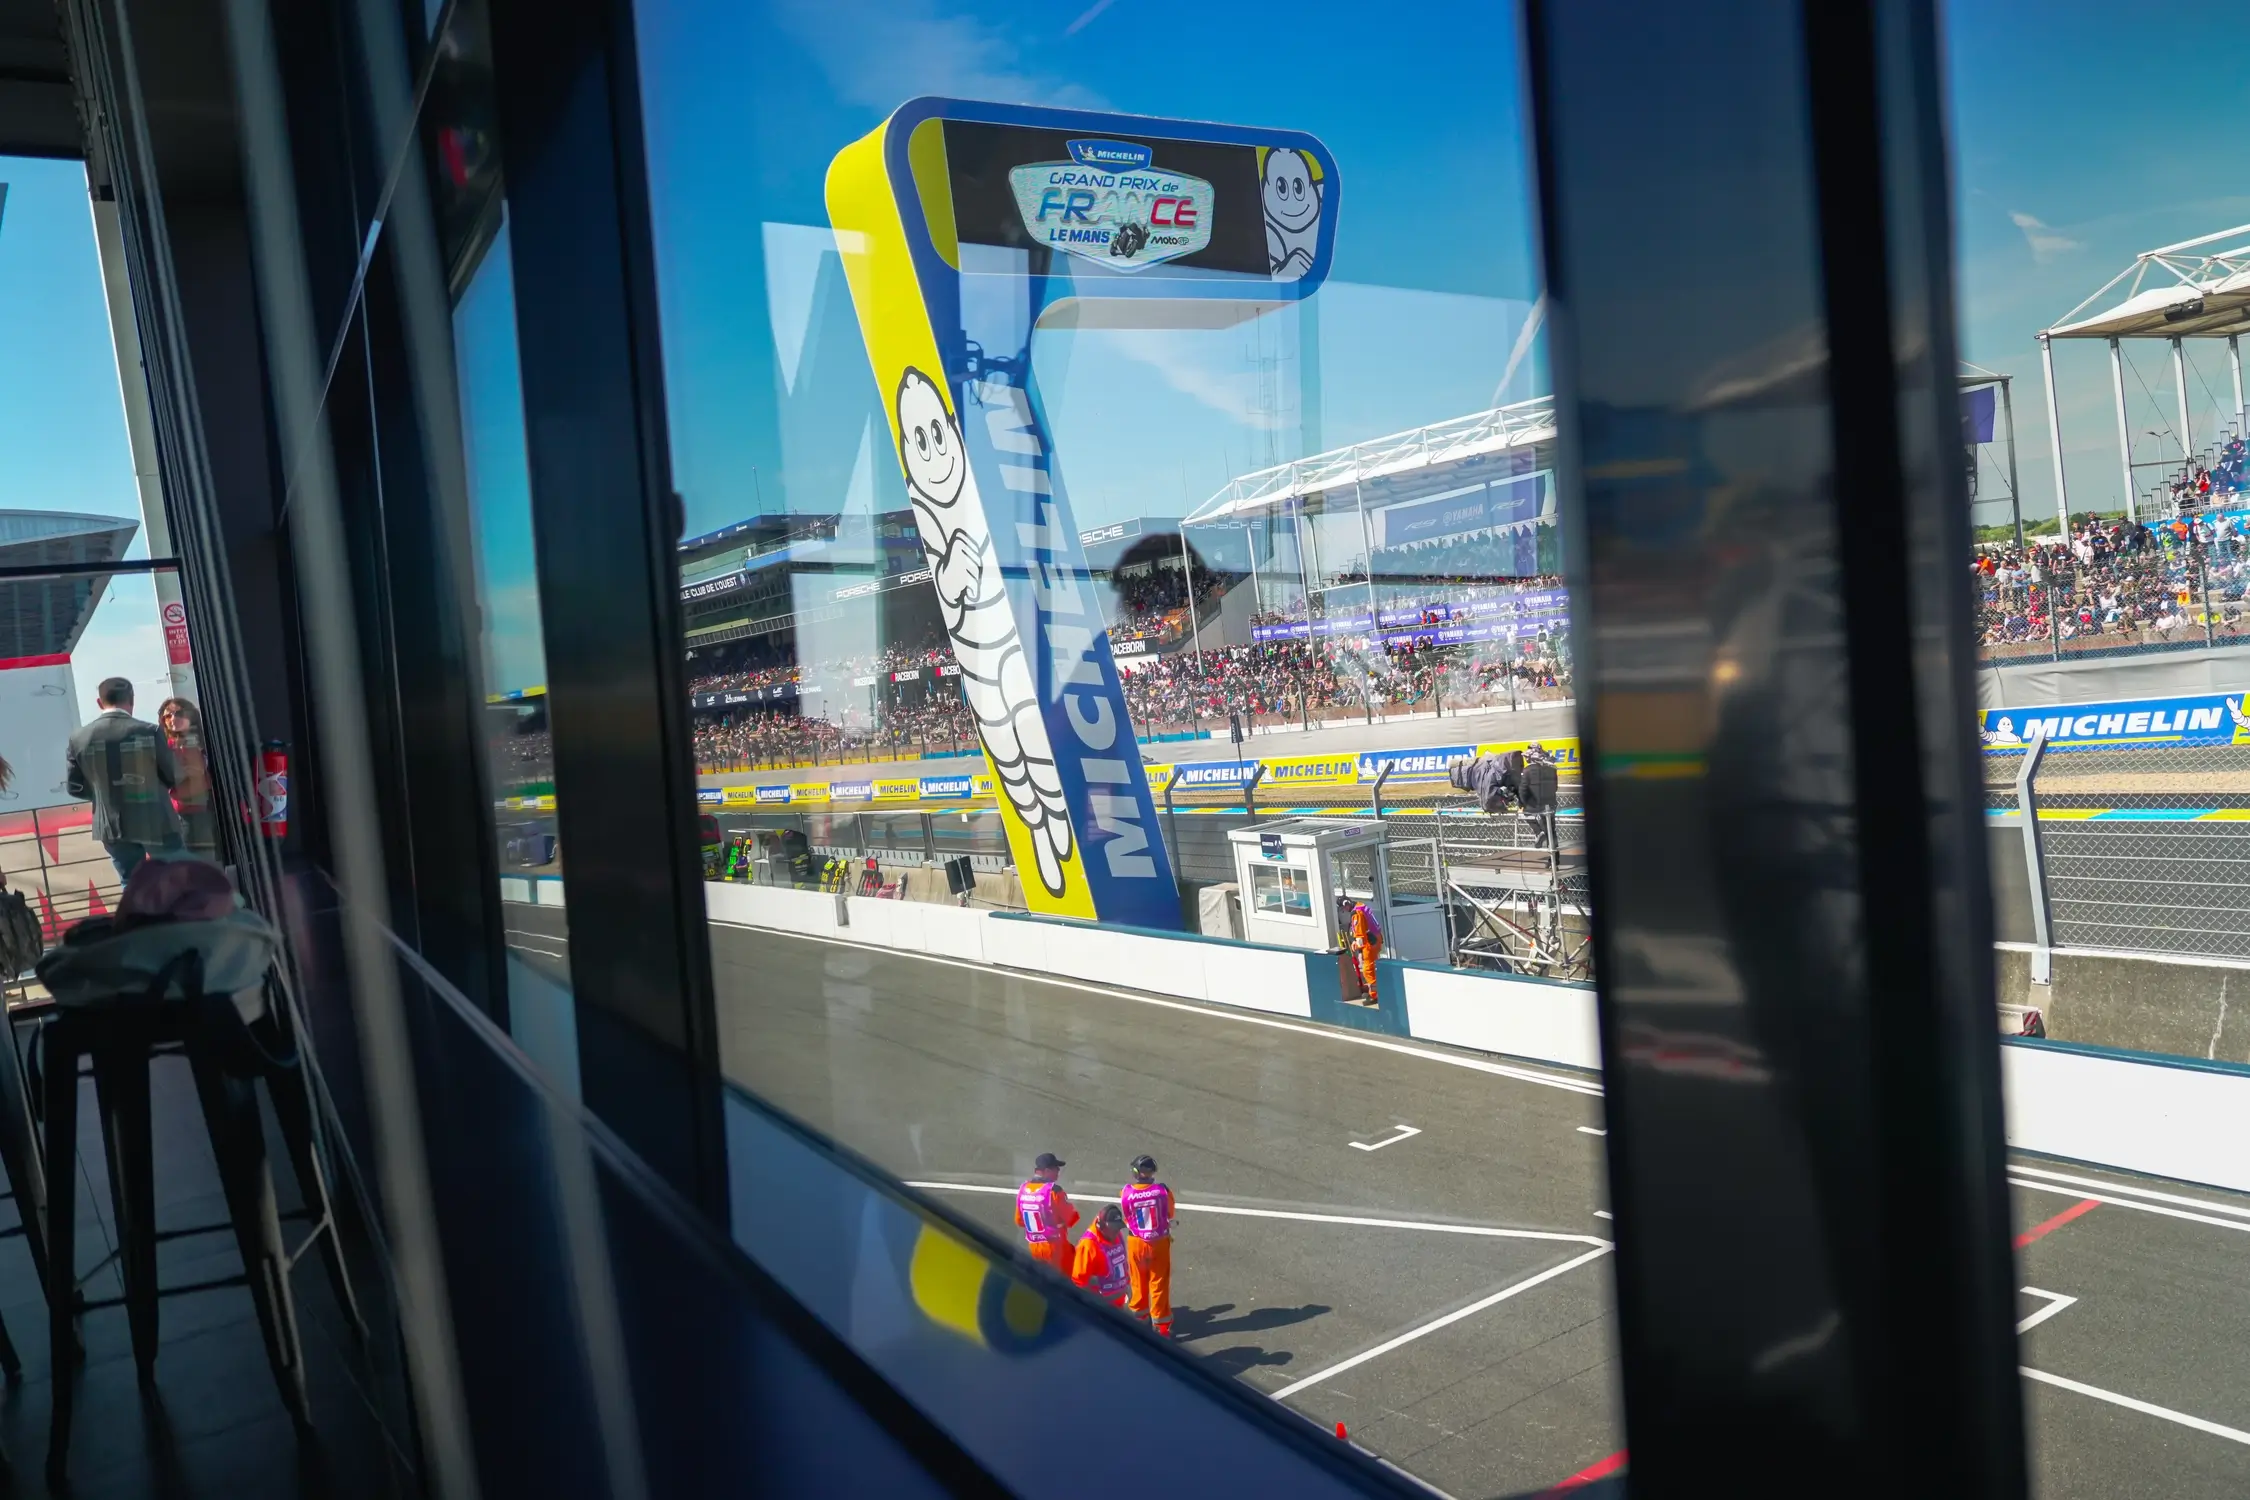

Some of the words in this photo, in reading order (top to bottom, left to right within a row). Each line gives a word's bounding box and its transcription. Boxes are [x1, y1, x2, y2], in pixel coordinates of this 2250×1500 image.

[1097, 149, 1145, 161] MICHELIN
[1049, 172, 1115, 188] GRAND
[1120, 176, 1160, 191] PRIX
[1162, 182, 1179, 193] de
[1036, 188, 1198, 228] FRANCE
[1049, 228, 1067, 241] LE
[1069, 229, 1110, 243] MANS
[1453, 503, 1484, 521] YAMAHA
[1080, 525, 1124, 544] SCHE
[690, 585, 706, 597] CLUB
[706, 583, 715, 593] DE
[714, 577, 737, 591] L'OUEST
[836, 582, 881, 600] PORSCHE
[978, 379, 1158, 879] MICHELIN
[894, 670, 920, 682] RACEBORN
[2022, 707, 2224, 740] MICHELIN
[1186, 766, 1254, 782] MICHELIN
[1274, 762, 1352, 777] MICHELIN
[761, 789, 789, 798] MICHELIN
[796, 788, 827, 797] MICHELIN
[835, 785, 871, 796] MICHELIN
[880, 784, 917, 794] MICHELIN
[928, 780, 969, 792] MICHELIN
[728, 791, 754, 799] MICHELIN
